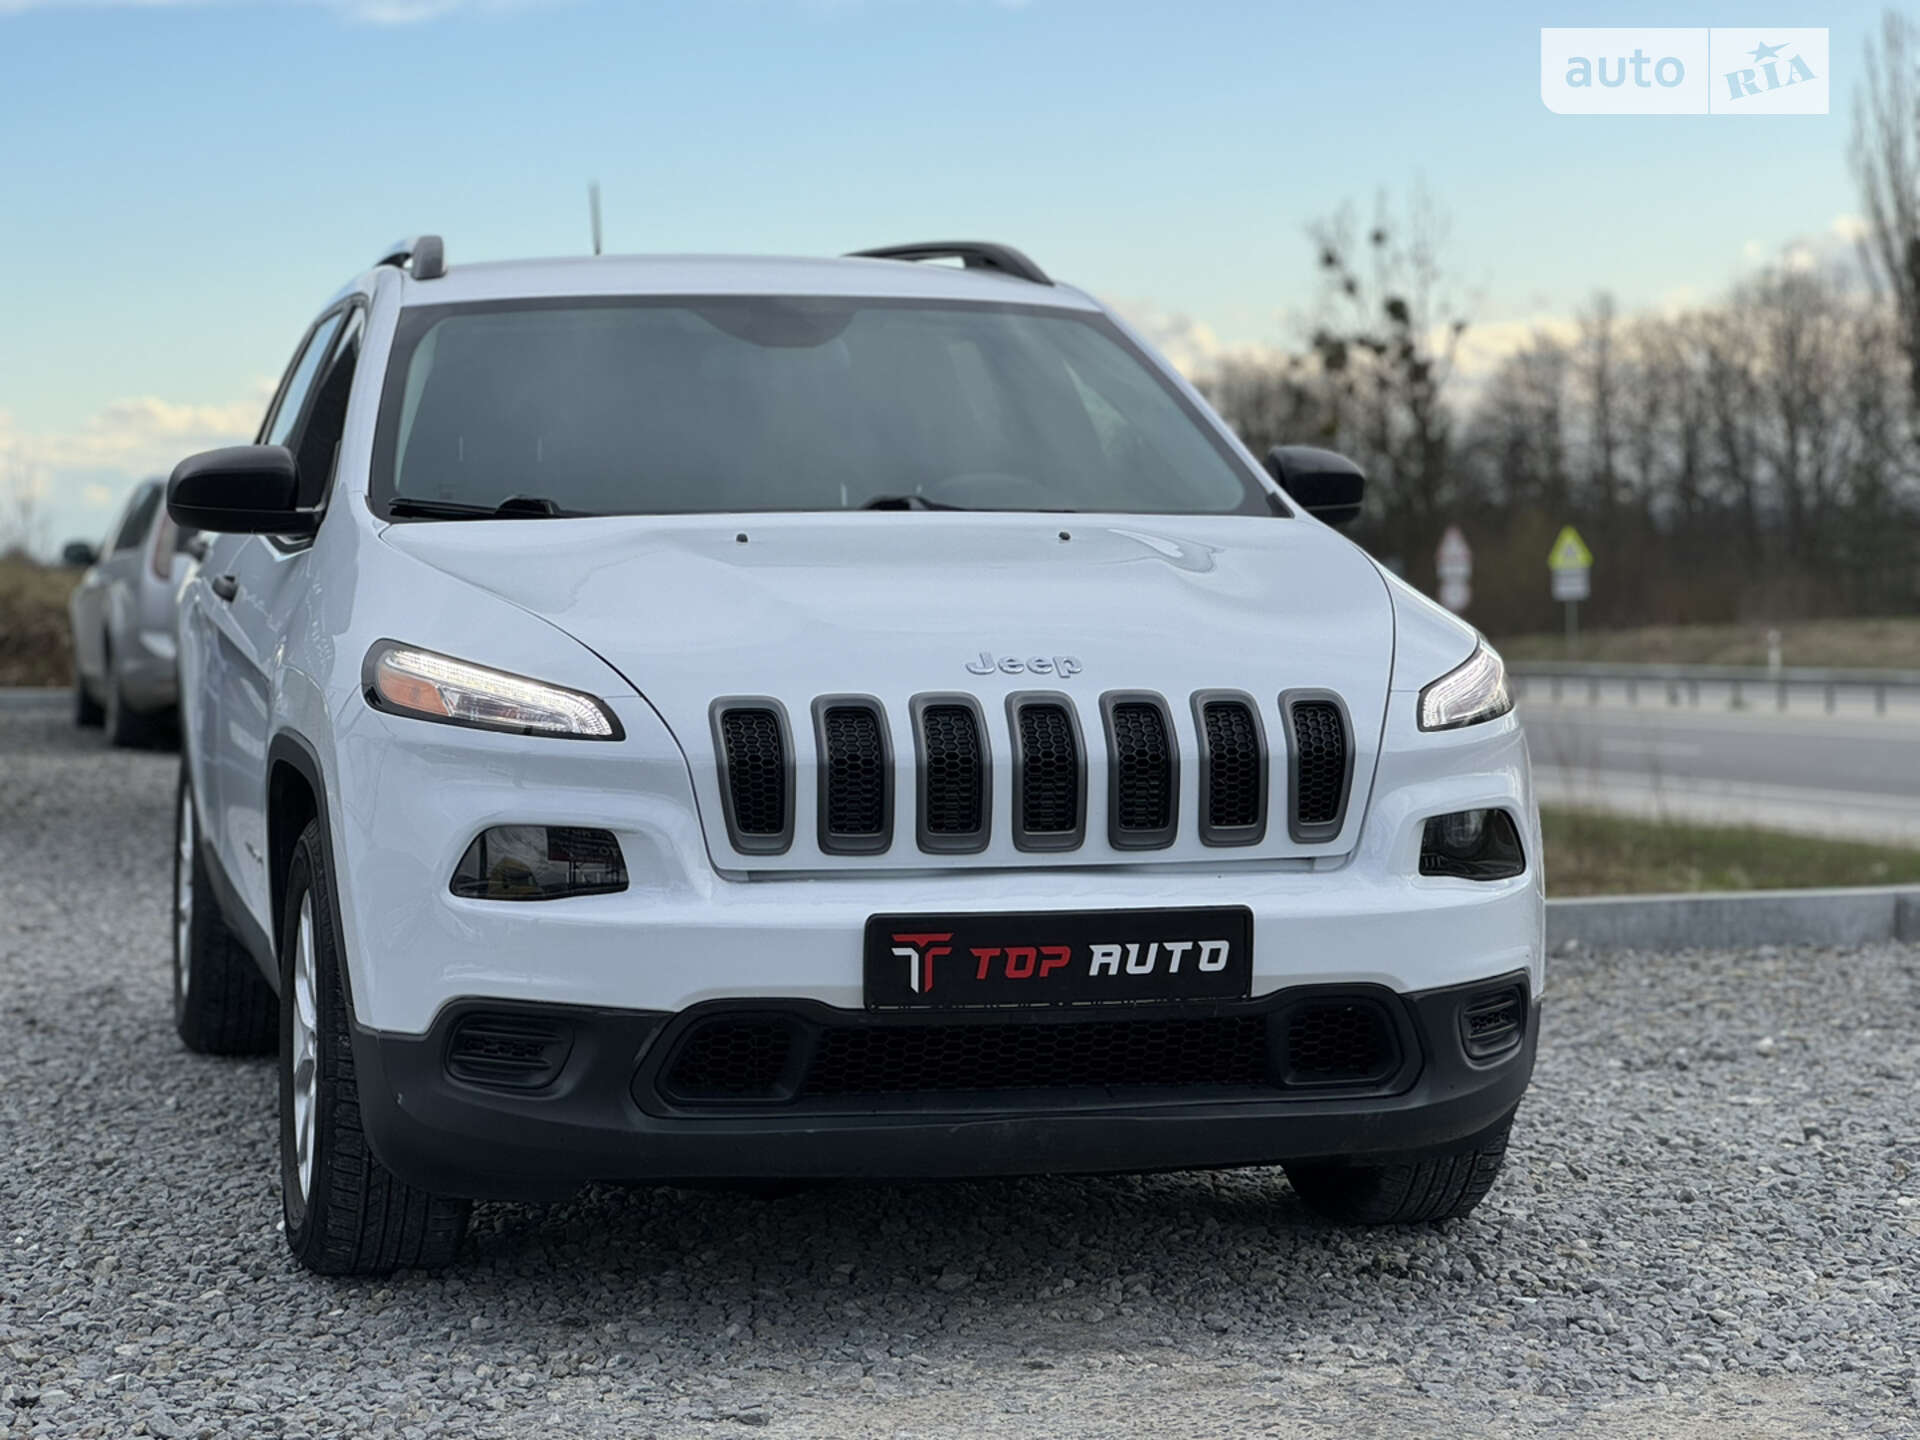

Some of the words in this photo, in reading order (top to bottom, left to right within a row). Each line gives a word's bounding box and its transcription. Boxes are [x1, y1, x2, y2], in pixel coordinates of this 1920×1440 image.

[965, 651, 1082, 678] Jeep
[969, 945, 1072, 980] TOP
[1087, 939, 1230, 976] AUTO
